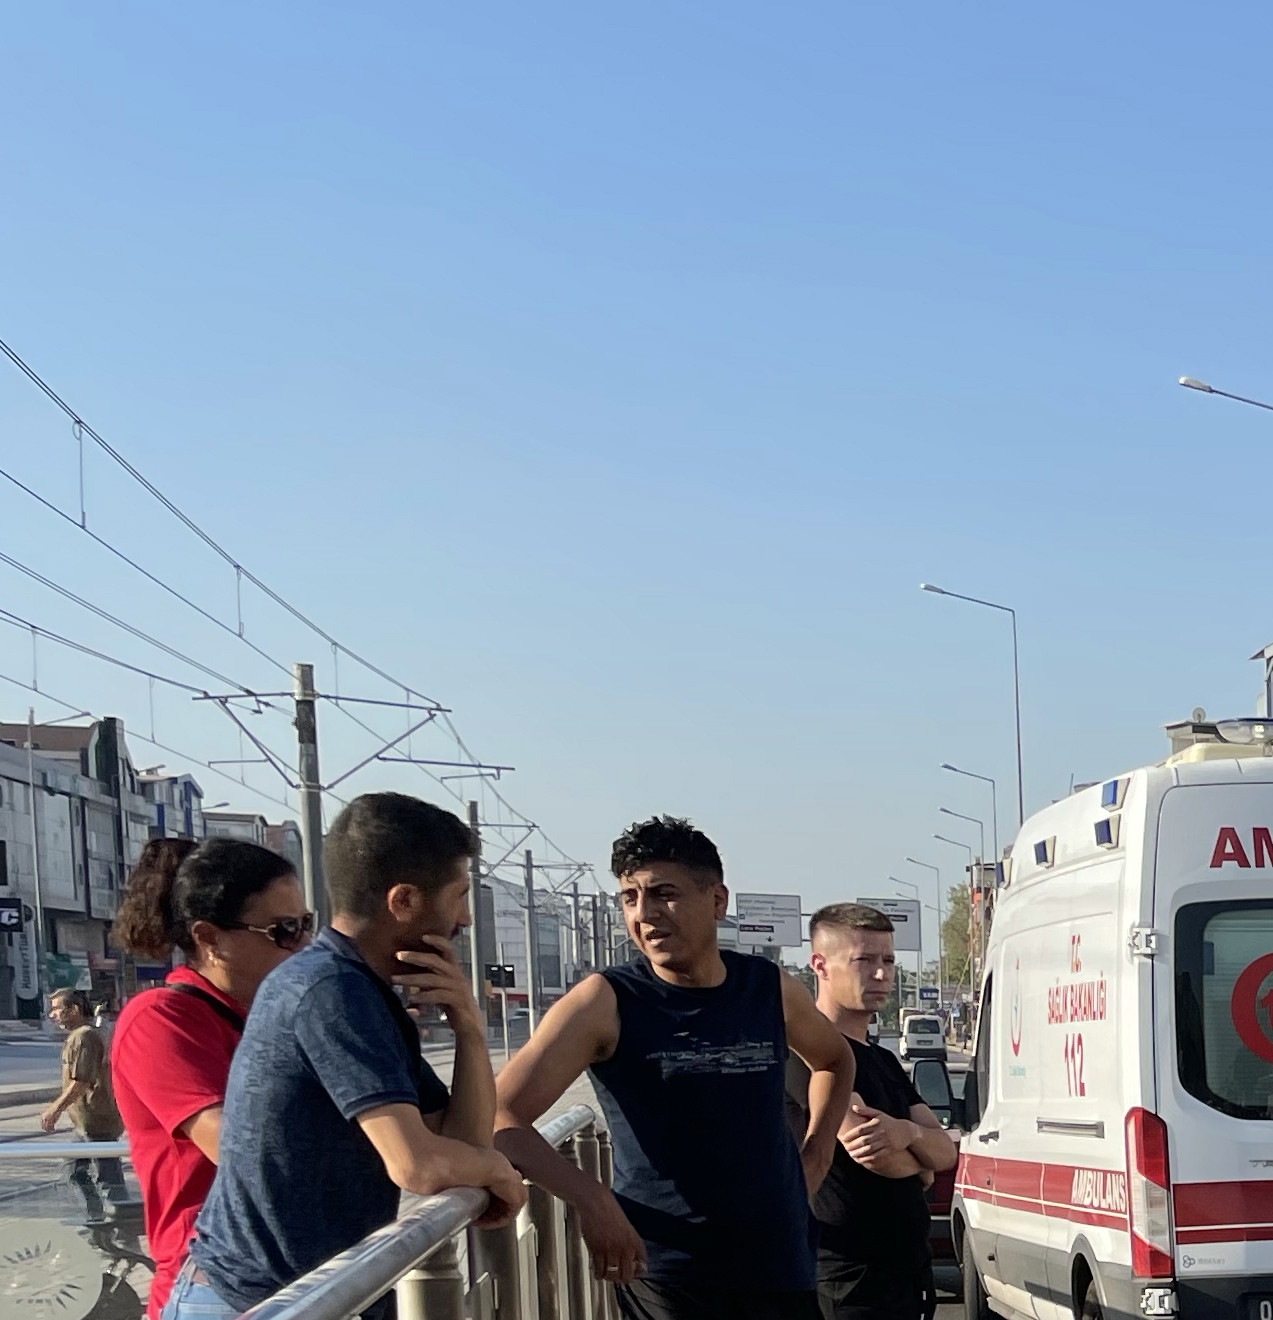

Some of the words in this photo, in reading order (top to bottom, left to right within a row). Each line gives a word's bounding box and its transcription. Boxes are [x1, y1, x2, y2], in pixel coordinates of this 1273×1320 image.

[1048, 977, 1069, 1025] SAĞLIK
[1064, 1032, 1086, 1097] 112
[1071, 1169, 1126, 1213] AMBULANS
